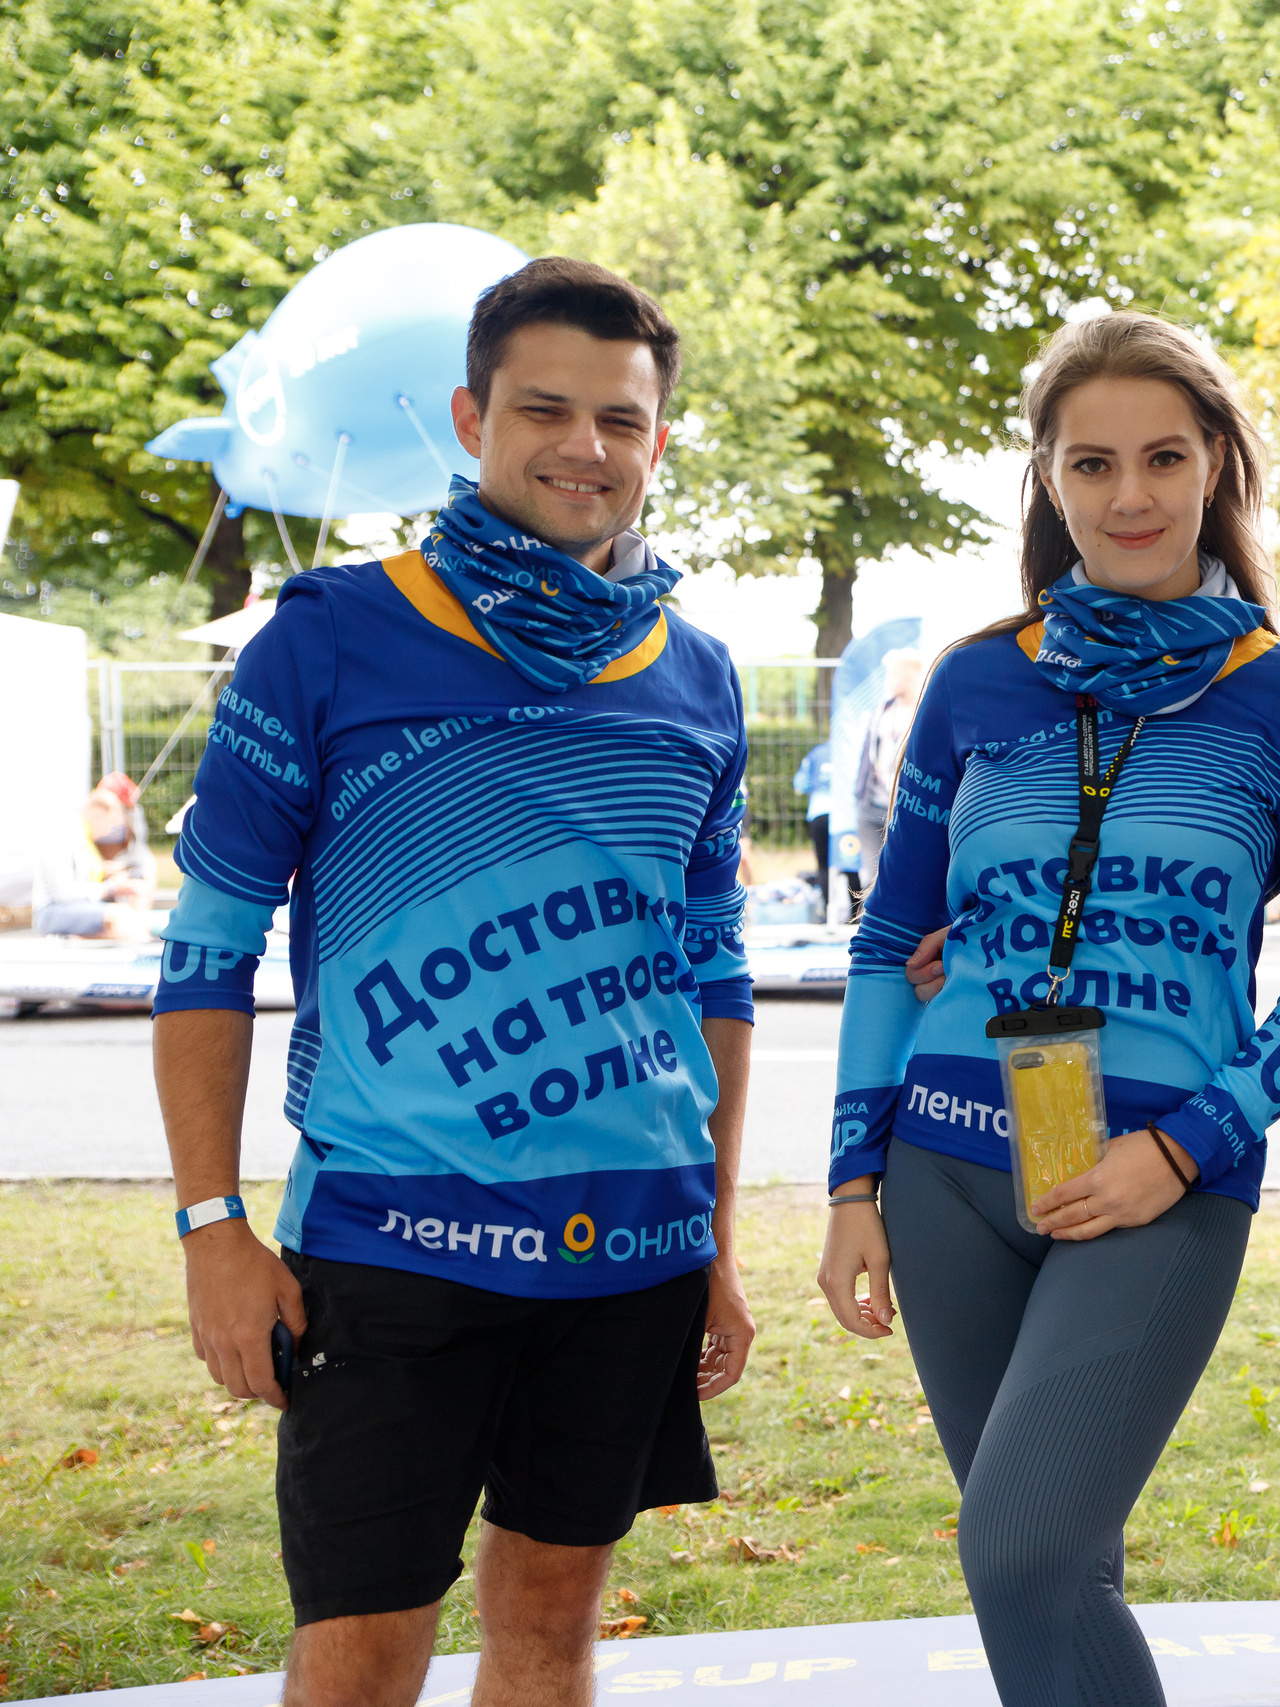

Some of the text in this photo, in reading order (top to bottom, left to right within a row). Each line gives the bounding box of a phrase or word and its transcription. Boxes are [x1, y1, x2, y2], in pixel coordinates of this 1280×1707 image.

[436, 997, 547, 1089] на
[474, 1029, 678, 1140] волне
[378, 1209, 547, 1262] лента
[603, 1657, 858, 1694] SUP
